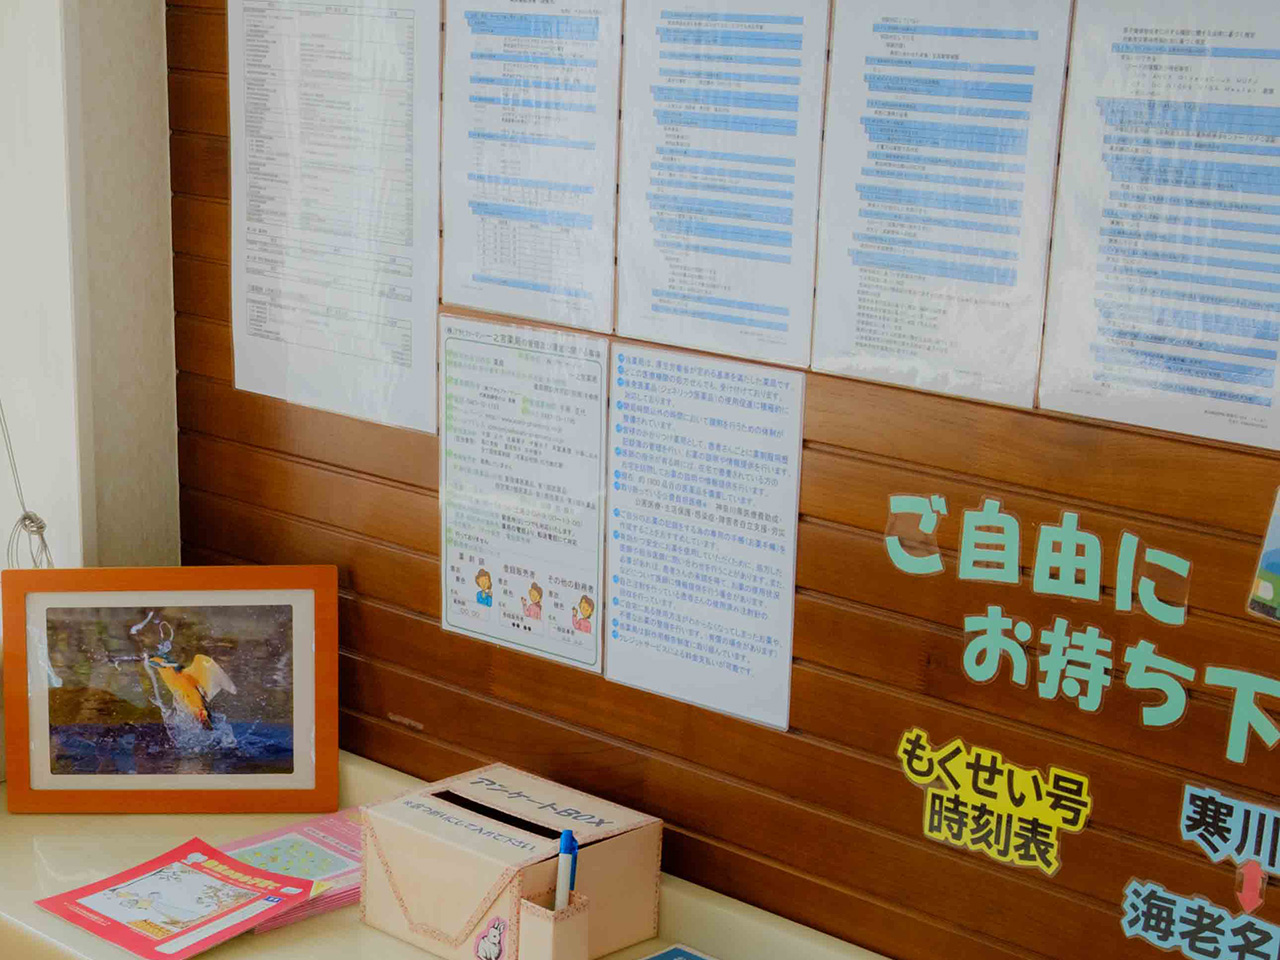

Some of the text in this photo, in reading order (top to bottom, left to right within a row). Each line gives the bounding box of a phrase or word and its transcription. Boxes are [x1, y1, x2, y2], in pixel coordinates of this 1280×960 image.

[885, 494, 1191, 625] ご自由に
[963, 605, 1280, 764] お持ち下
[469, 775, 616, 828] アンケートBOX
[901, 732, 1089, 826] もくせい号
[927, 793, 1055, 869] 時刻表
[1185, 792, 1280, 868] 寒川
